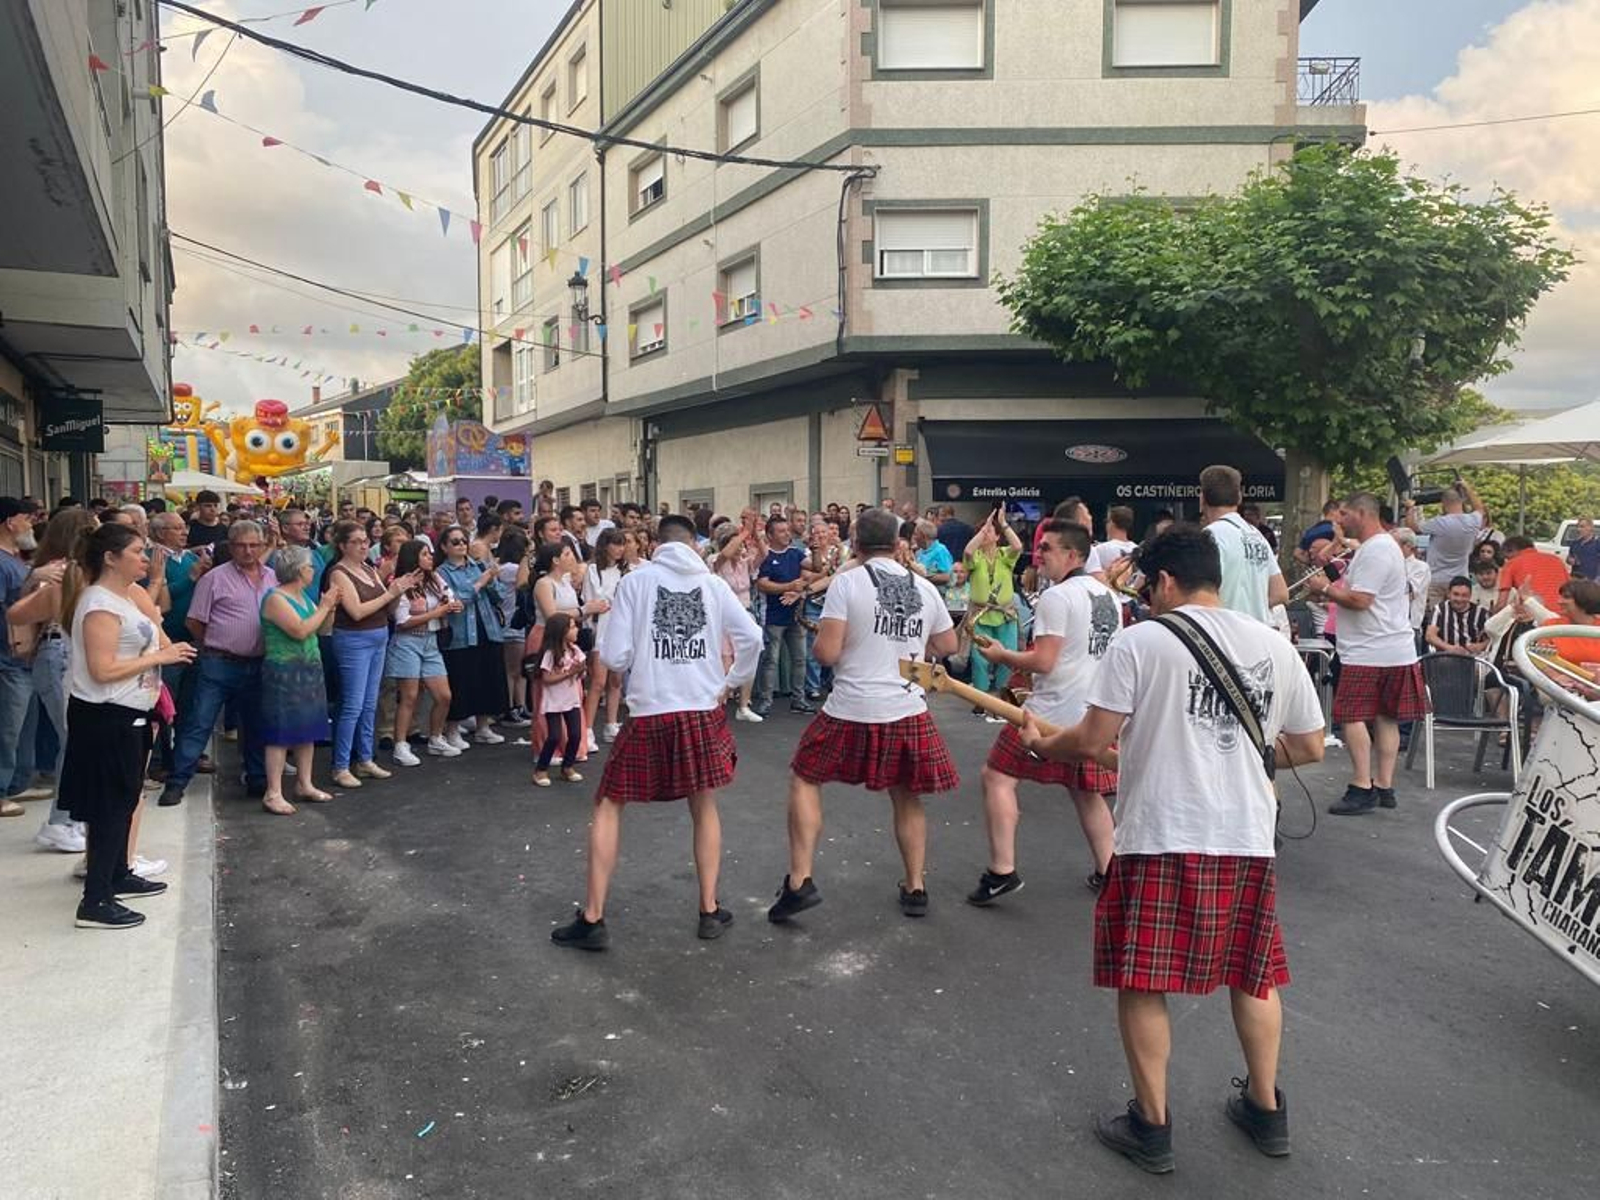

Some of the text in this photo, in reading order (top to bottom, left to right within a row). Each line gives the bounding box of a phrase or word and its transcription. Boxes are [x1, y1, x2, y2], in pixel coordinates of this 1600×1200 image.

[972, 486, 1040, 497] Estrella Galicia
[1116, 482, 1276, 498] OS CASTIÑEIRO LORIA
[1526, 774, 1566, 822] LOS
[1506, 805, 1600, 935] TÁM
